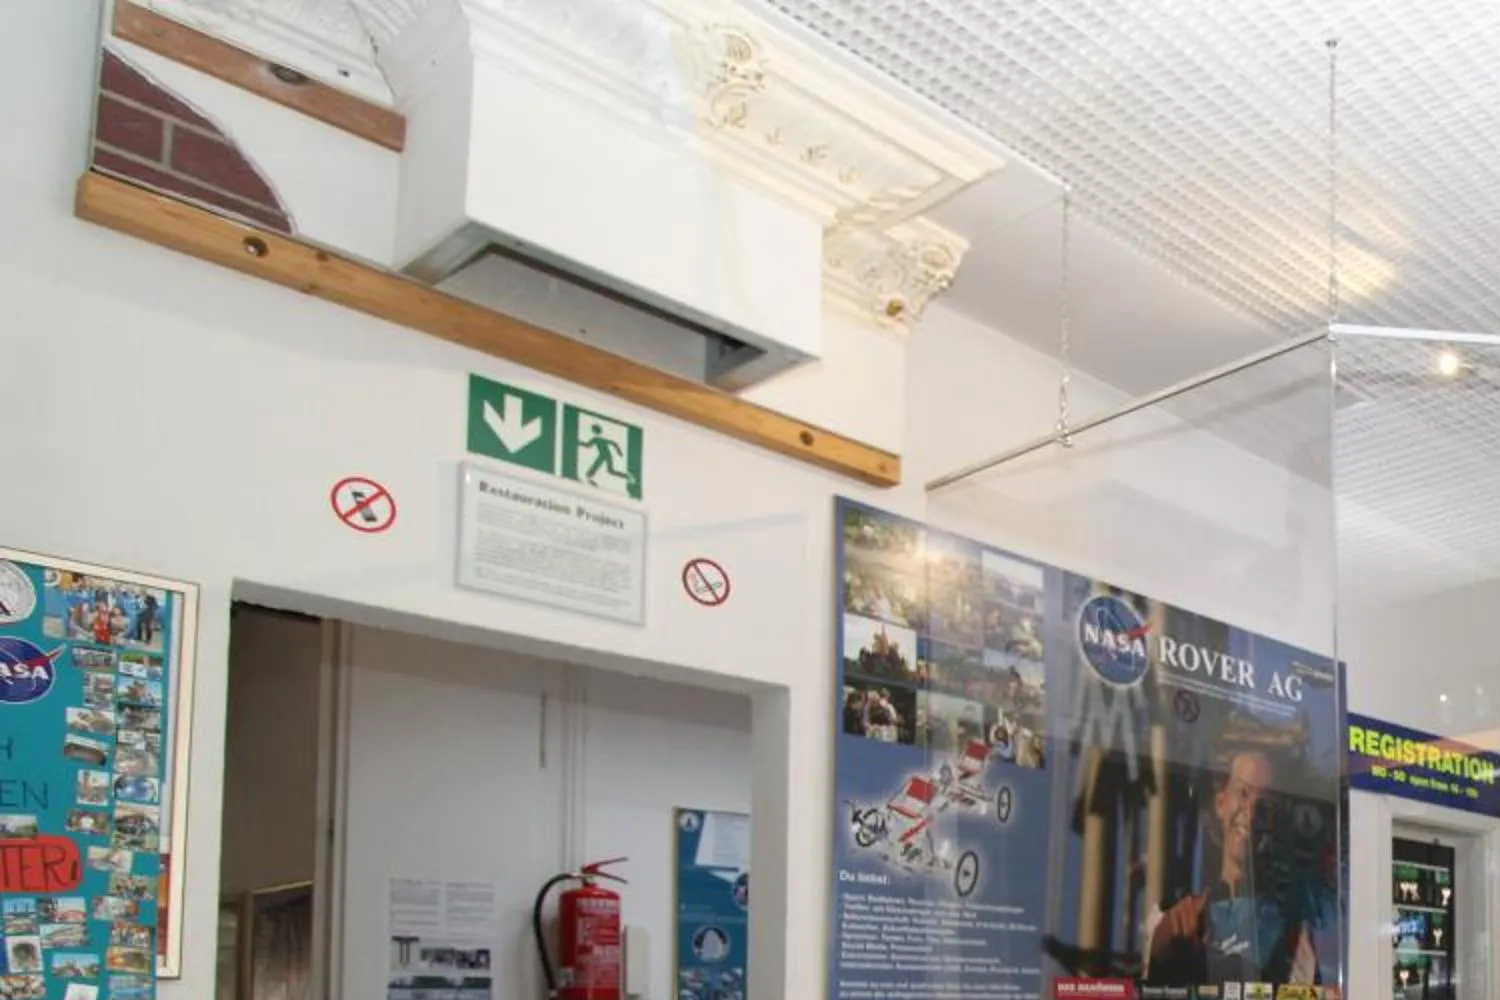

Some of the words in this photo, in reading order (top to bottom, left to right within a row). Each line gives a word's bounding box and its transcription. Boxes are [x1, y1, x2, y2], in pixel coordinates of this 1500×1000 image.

[1084, 623, 1146, 657] NASA
[0, 662, 49, 682] ASA
[1159, 635, 1256, 689] ROVER
[1267, 671, 1303, 702] AG
[1348, 725, 1495, 785] REGISTRATION
